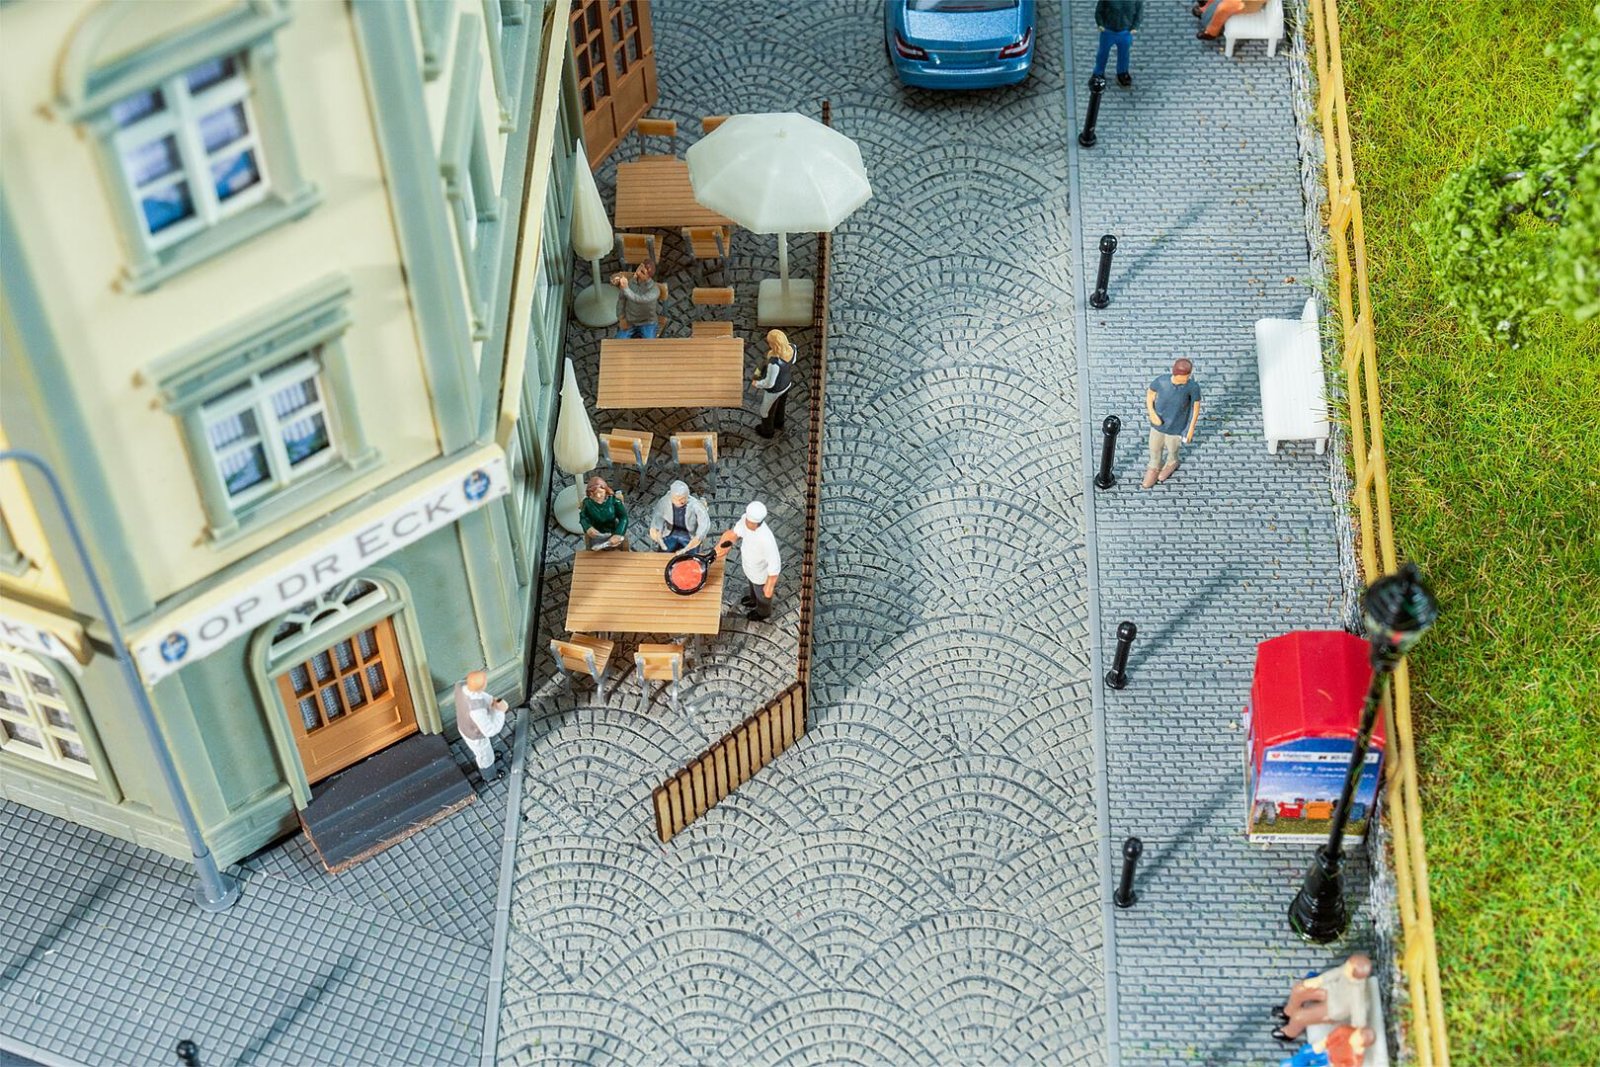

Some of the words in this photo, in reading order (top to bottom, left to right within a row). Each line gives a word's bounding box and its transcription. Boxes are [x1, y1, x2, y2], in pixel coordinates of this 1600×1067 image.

[199, 598, 259, 641] OP
[277, 554, 342, 600] DR
[355, 494, 452, 558] ECK
